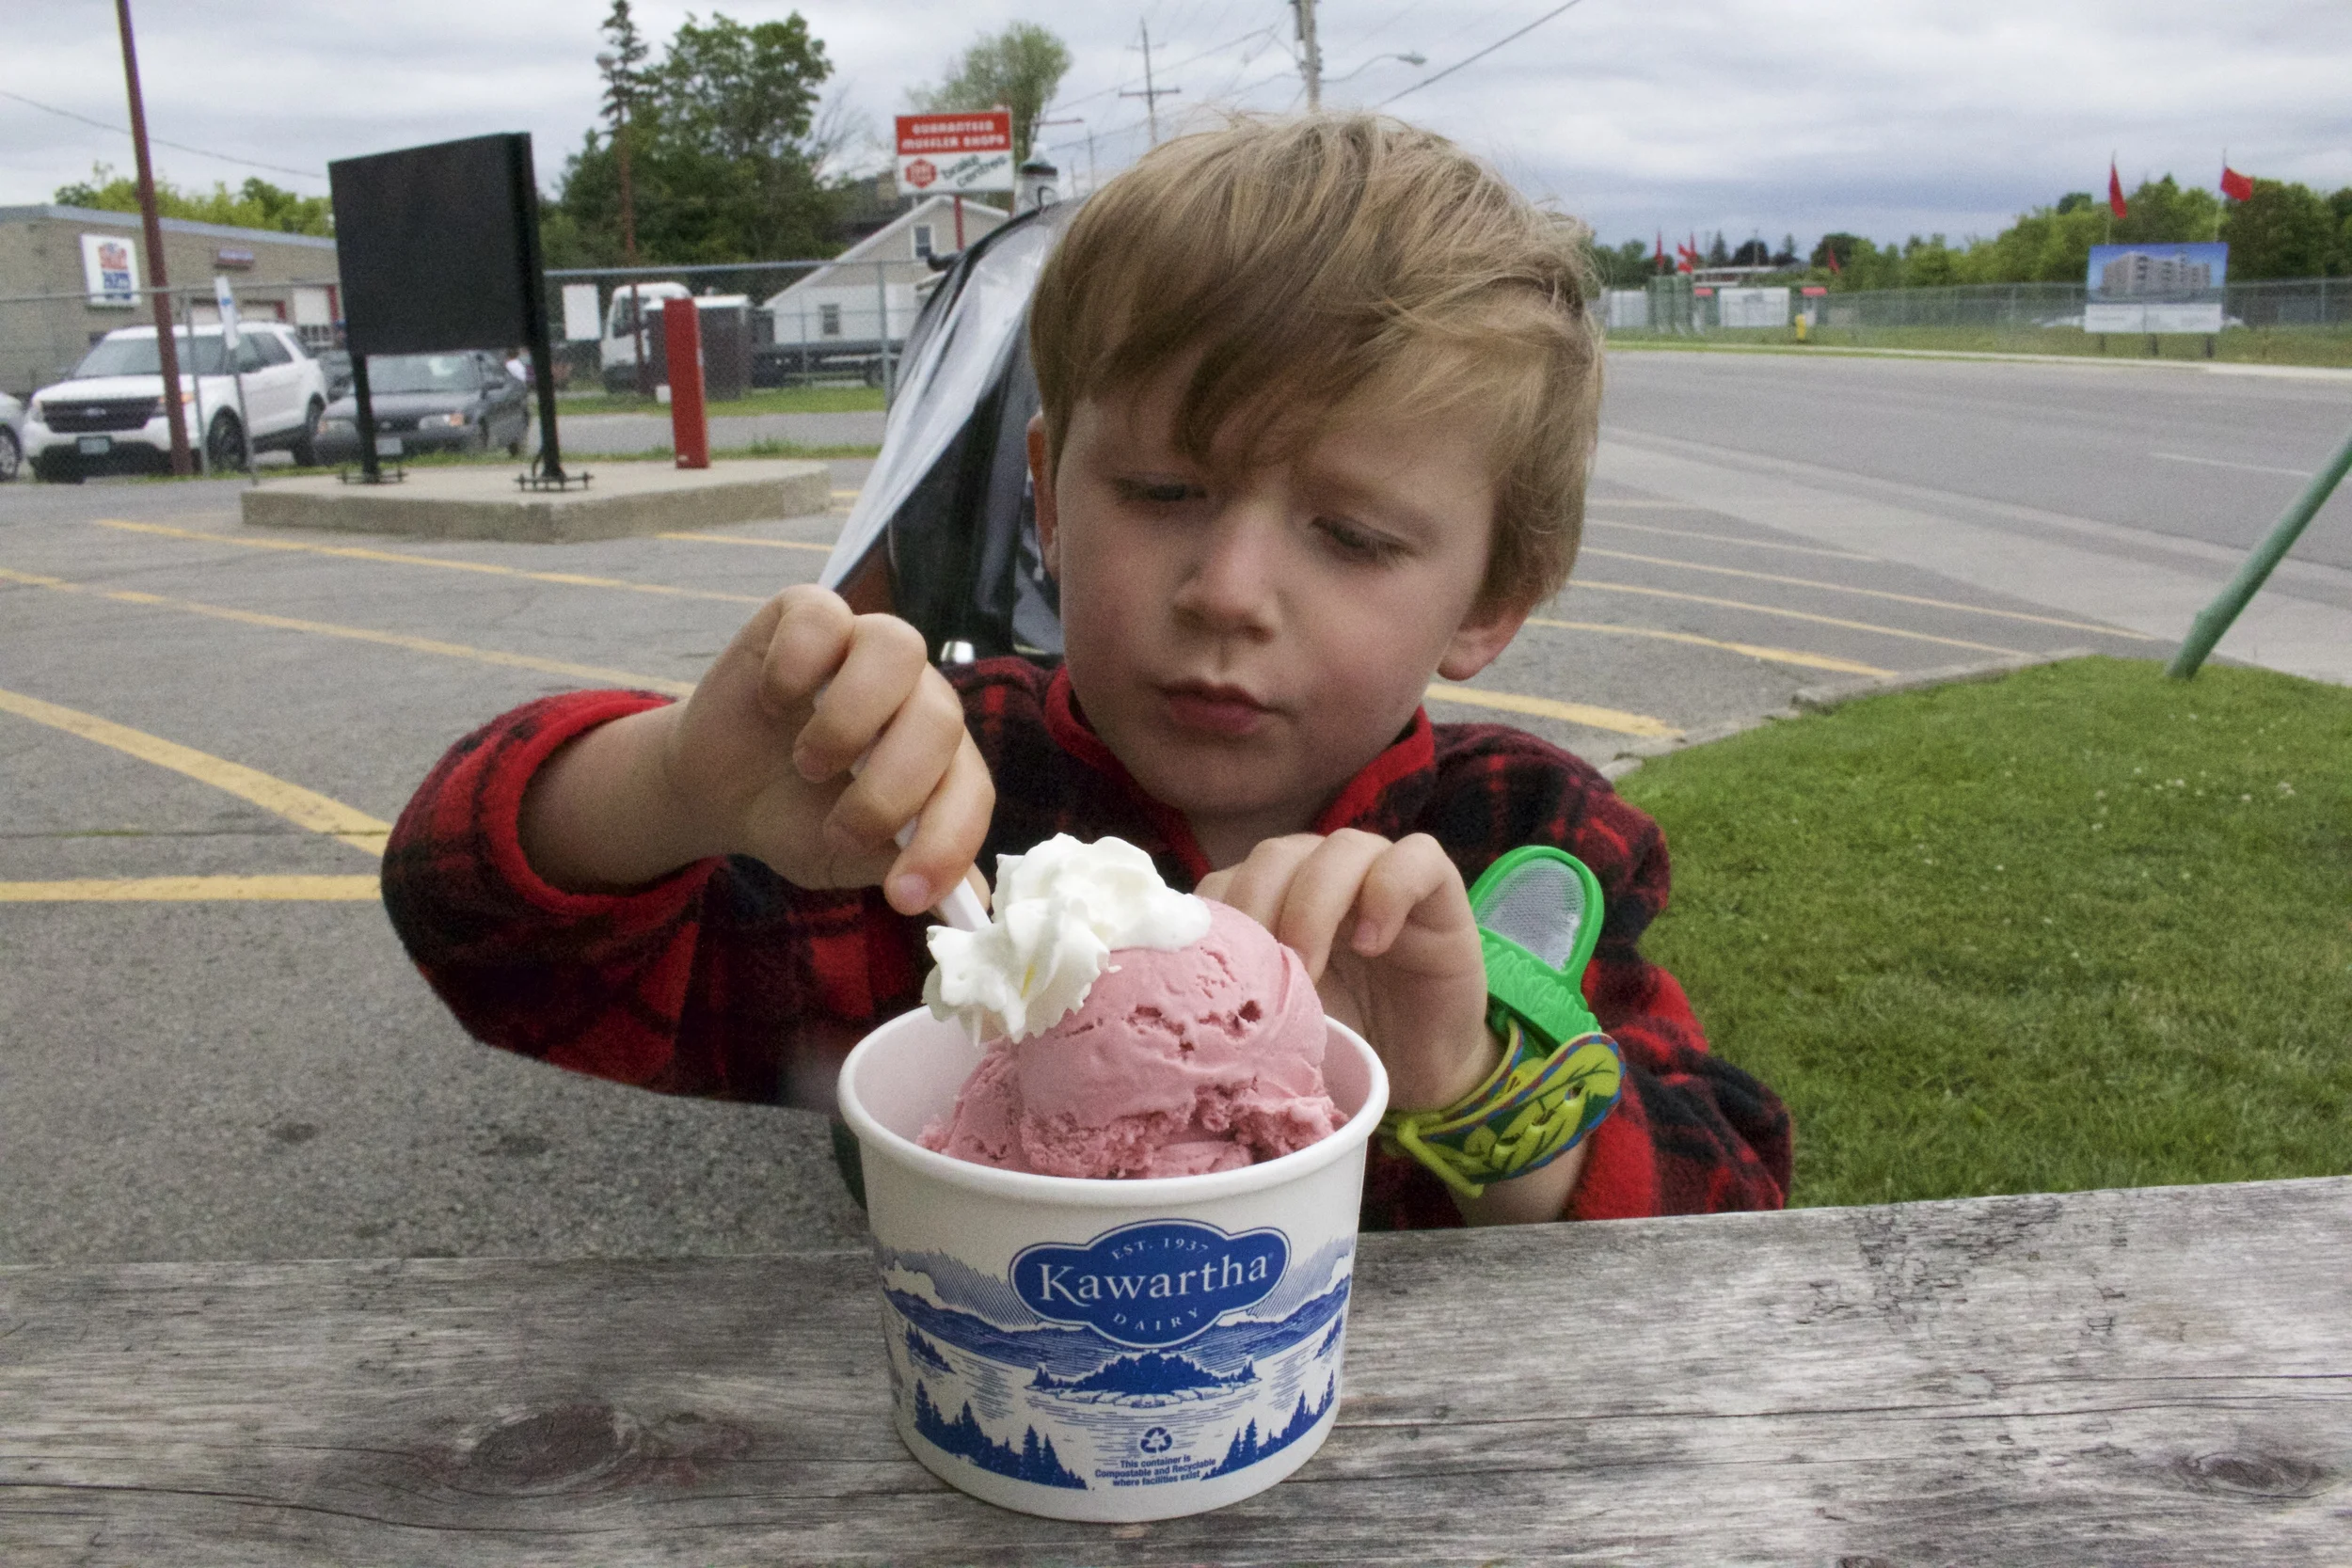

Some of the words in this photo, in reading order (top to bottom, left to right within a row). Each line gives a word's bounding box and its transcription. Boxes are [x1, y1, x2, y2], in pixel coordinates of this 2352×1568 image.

[912, 120, 993, 135] GUARANTEED
[1112, 1239, 1152, 1260] EST.
[1164, 1238, 1210, 1255] 1937
[1037, 1254, 1268, 1307] Kawartha
[1113, 1307, 1200, 1331] DAIRY
[1095, 1468, 1152, 1481] Compostable
[1153, 1467, 1170, 1476] and
[1172, 1459, 1216, 1473] Recyclable
[1120, 1460, 1138, 1468] This
[1140, 1457, 1181, 1467] container
[1141, 1474, 1178, 1485] facilities
[1181, 1470, 1200, 1481] exist
